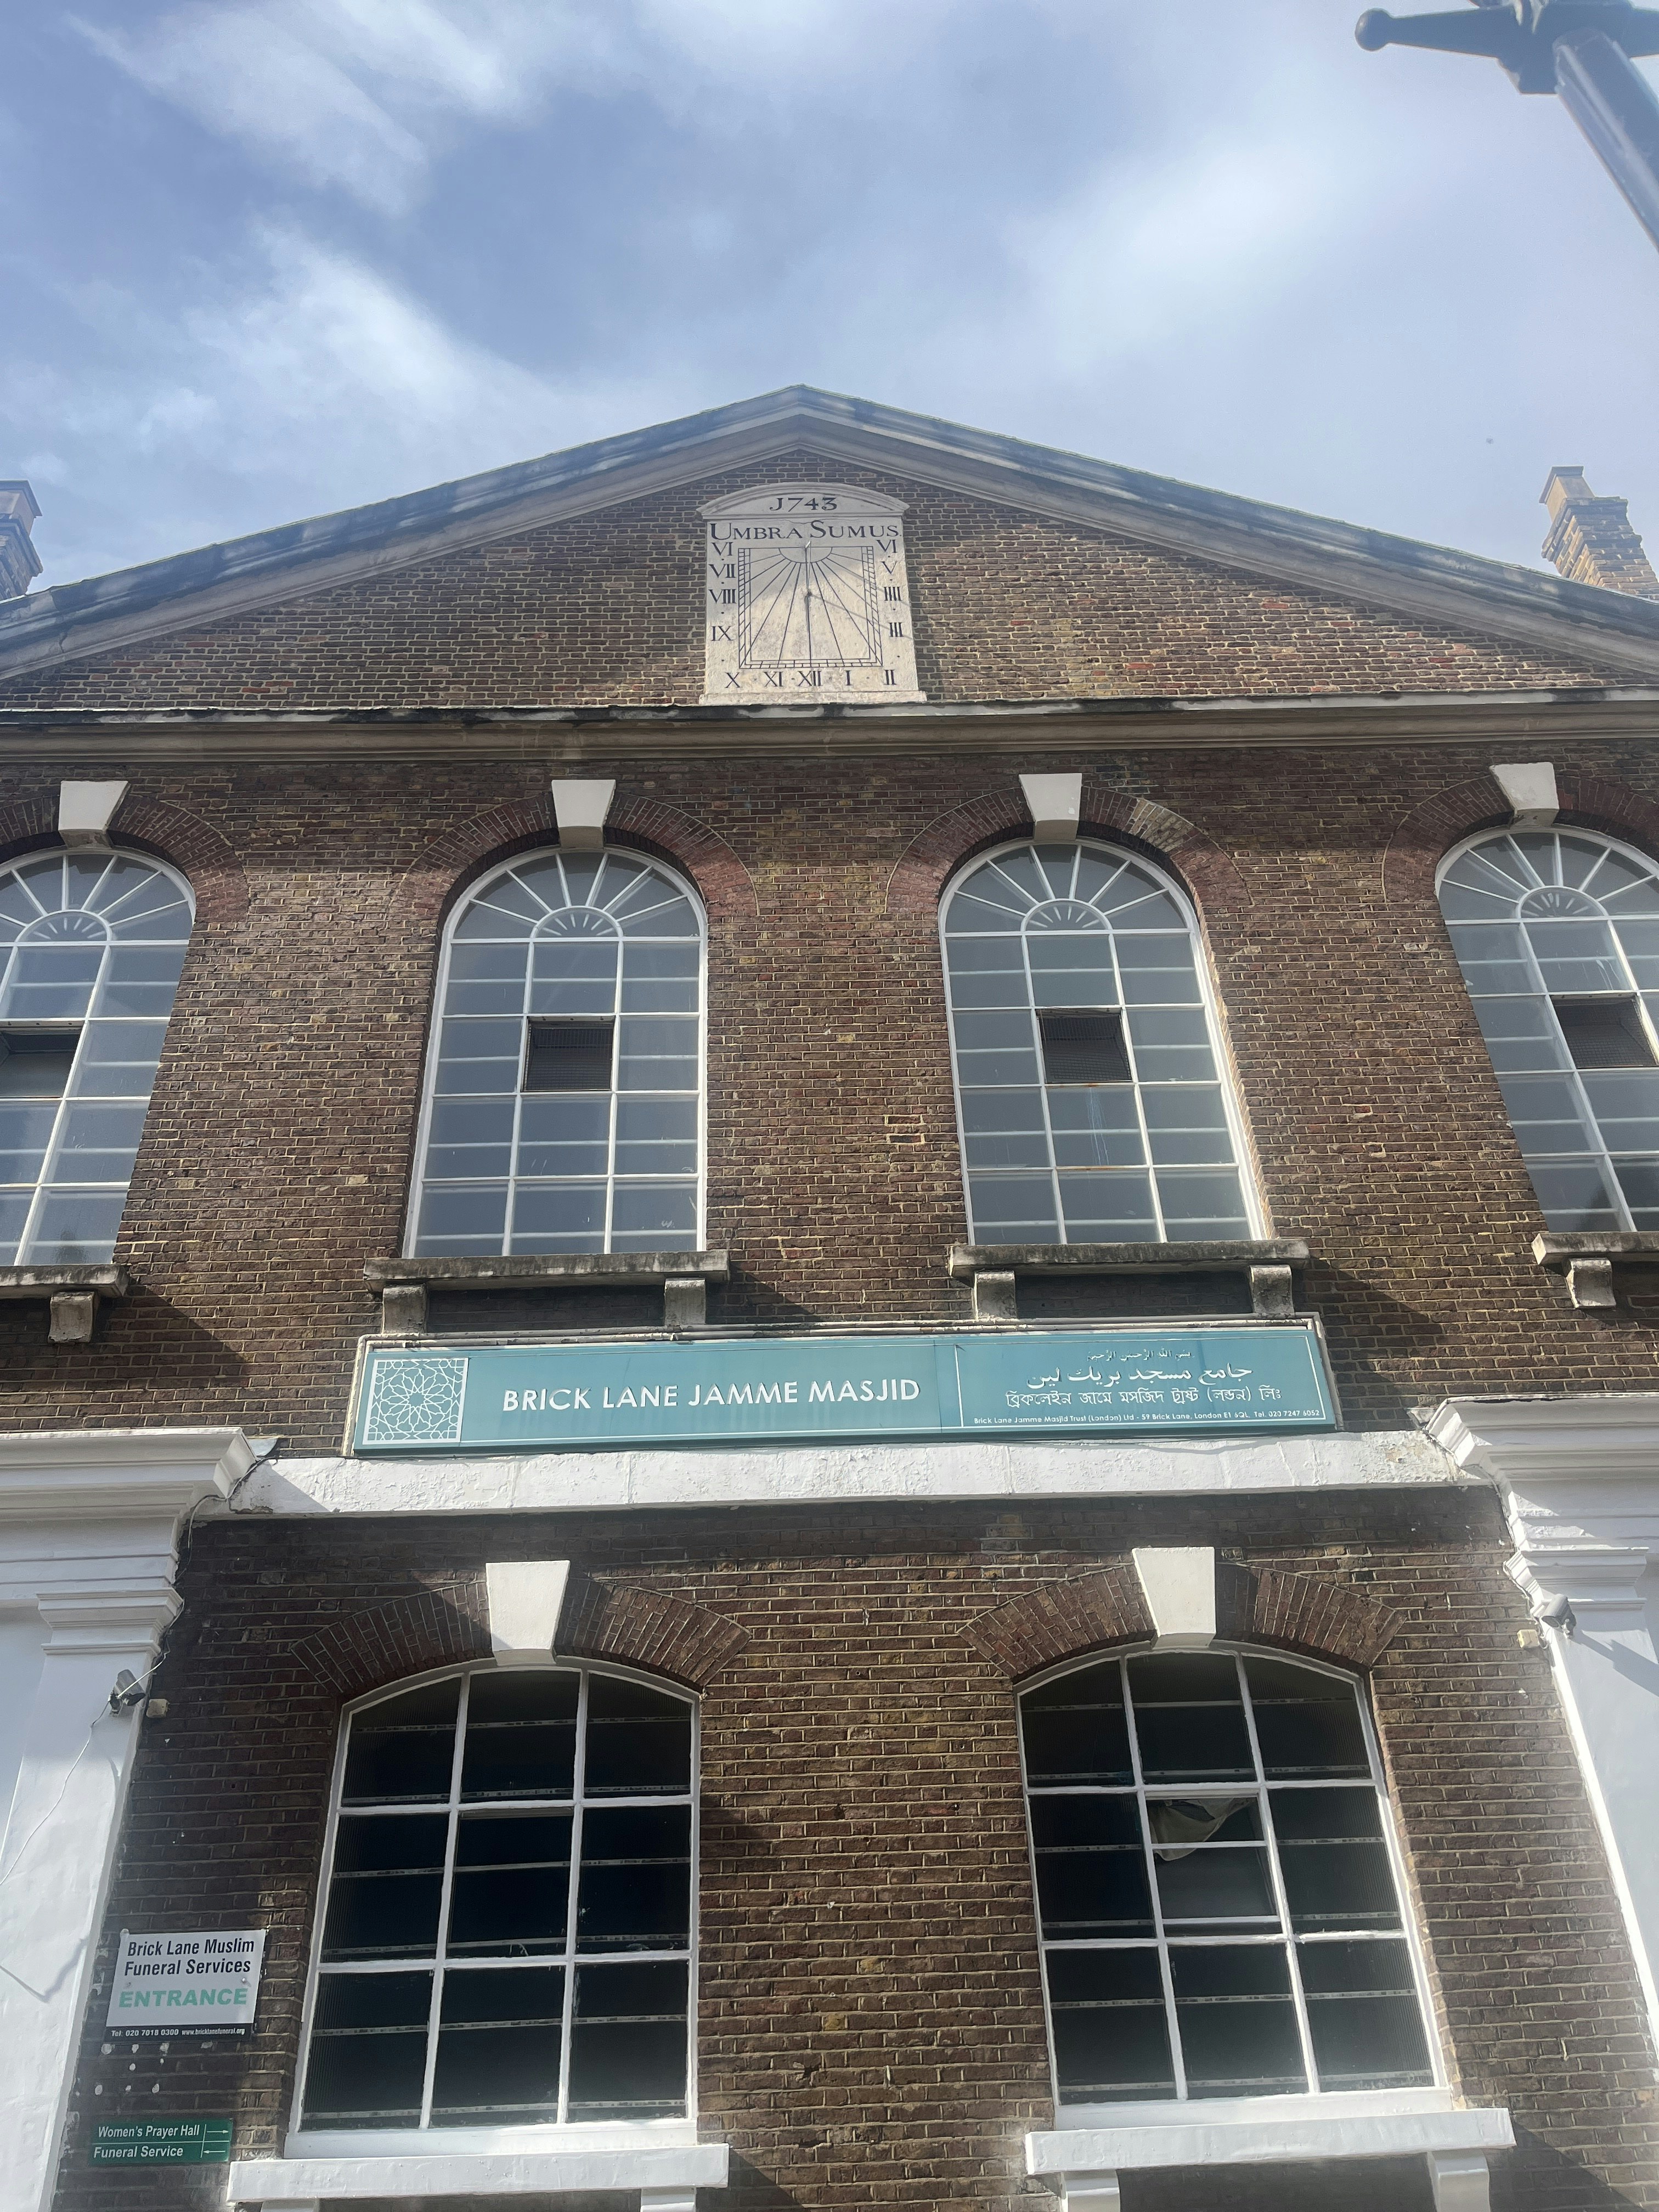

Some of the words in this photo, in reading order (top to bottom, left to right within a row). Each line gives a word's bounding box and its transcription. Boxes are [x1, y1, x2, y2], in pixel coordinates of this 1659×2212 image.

[710, 523, 803, 540] UMBRA
[712, 542, 733, 556] VI
[876, 539, 896, 554] VI
[709, 564, 736, 578] VII
[882, 561, 897, 574] V
[711, 626, 734, 641] IX
[889, 622, 904, 637] III
[725, 672, 741, 688] X
[764, 671, 783, 687] XI
[798, 670, 822, 686] XII
[845, 670, 853, 686] I
[884, 669, 896, 685] II
[1027, 1367, 1062, 1389] لين
[1128, 1368, 1192, 1384] مسجد
[1198, 1362, 1253, 1385] جامع
[503, 1387, 591, 1411] BRICK
[603, 1385, 678, 1408] LANE
[688, 1381, 798, 1407] JAMME
[808, 1379, 921, 1403] MASJID
[1078, 1392, 1112, 1404] জামে
[1118, 1387, 1165, 1403] মসজিদ
[1044, 1415, 1068, 1424] Masjid
[127, 1941, 162, 1956] Brick
[166, 1940, 199, 1955] Lane
[204, 1938, 254, 1954] Muslim
[125, 1960, 180, 1976] Funeral
[185, 1959, 251, 1974] Services
[119, 1988, 248, 2008] ENTRANCE
[145, 2125, 178, 2139] Prayer
[180, 2124, 200, 2136] Hall
[94, 2146, 137, 2158] Funeral
[140, 2145, 183, 2157] Service
